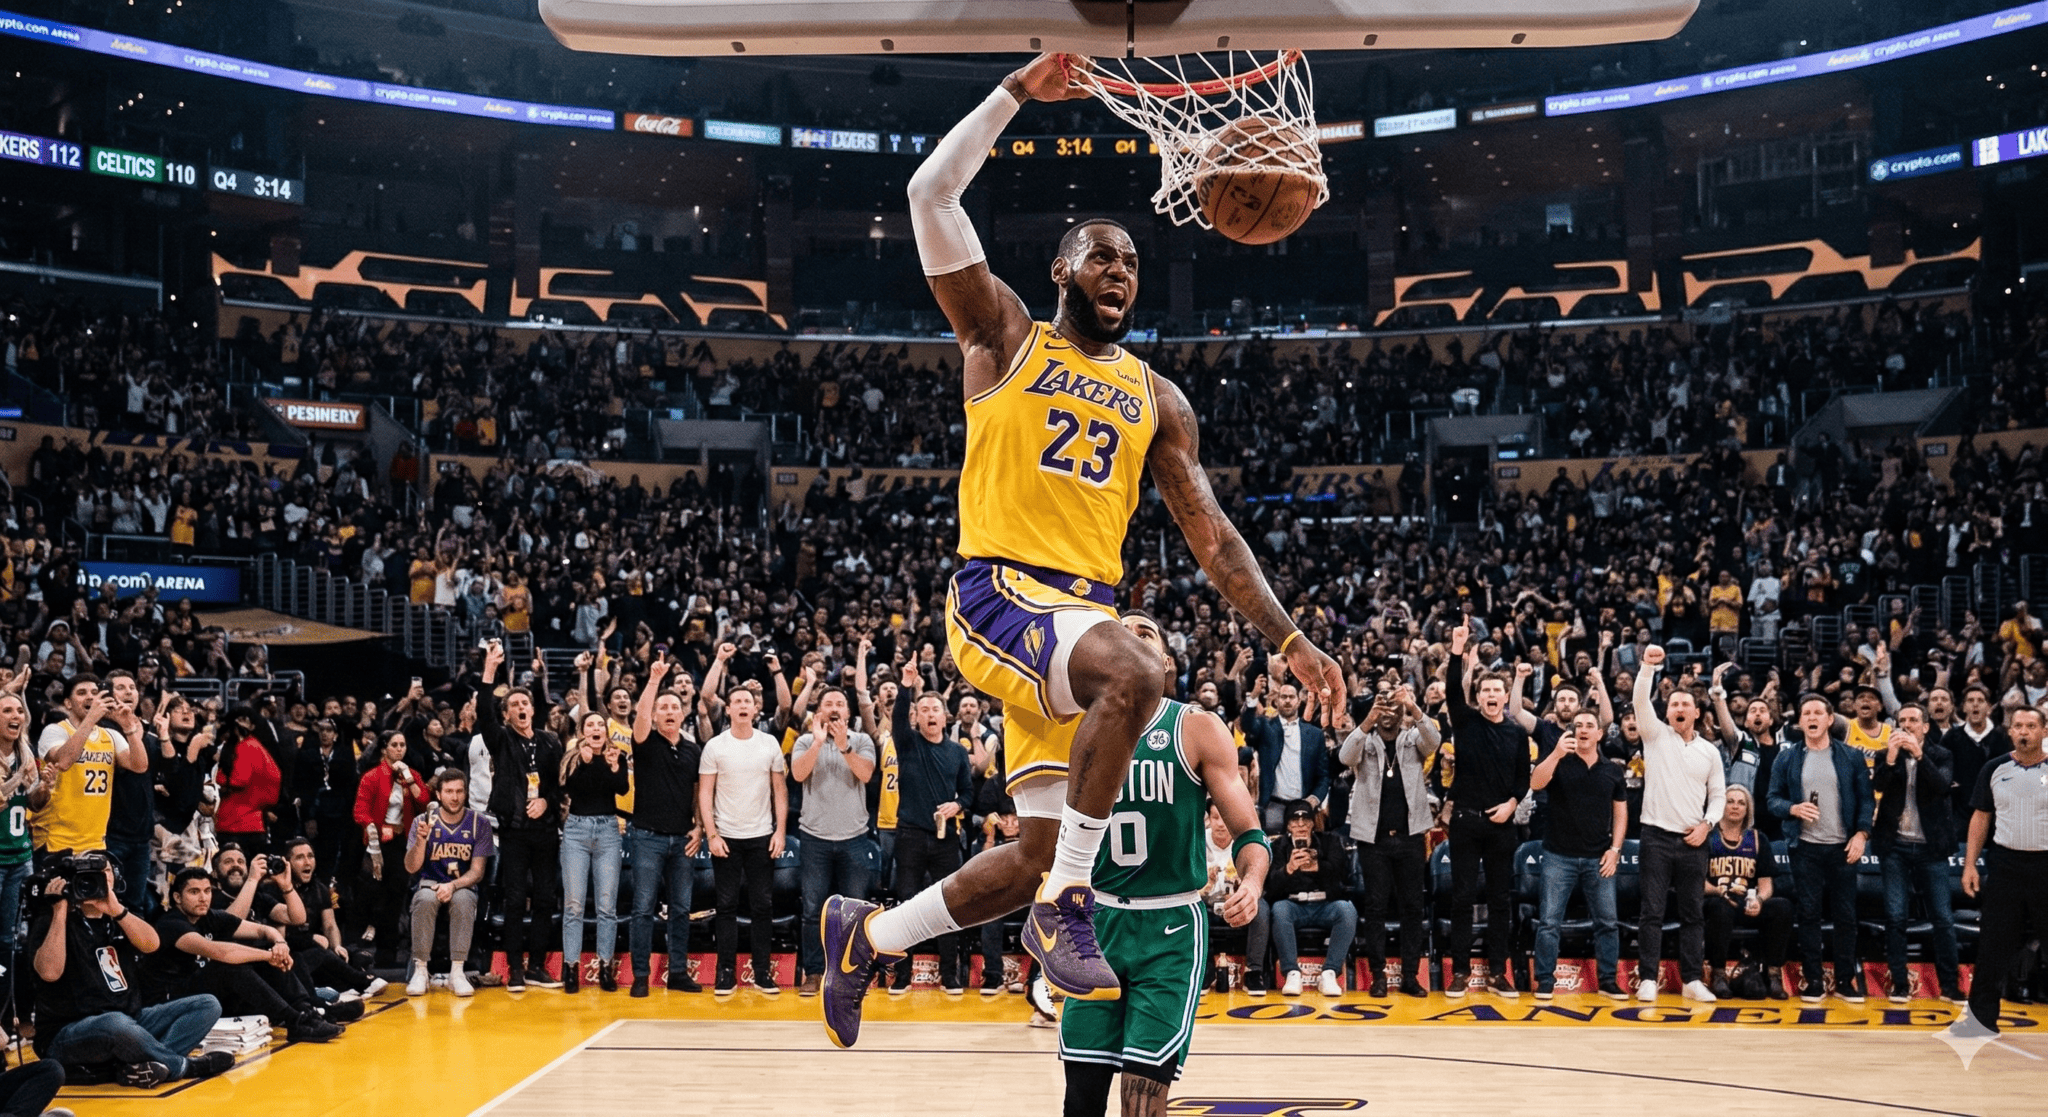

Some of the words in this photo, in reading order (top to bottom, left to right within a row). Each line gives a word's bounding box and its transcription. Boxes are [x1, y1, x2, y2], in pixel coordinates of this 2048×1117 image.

[49, 143, 81, 167] 112
[1012, 140, 1035, 155] Q4
[1056, 137, 1093, 156] 3:14
[97, 150, 156, 178] CELTICS
[166, 162, 195, 185] 110
[1890, 151, 1961, 173] crypto.com
[214, 171, 237, 190] Q4
[254, 175, 292, 199] 3:14
[1023, 358, 1143, 424] LAKERS
[287, 405, 360, 424] PESINERY
[1038, 407, 1121, 489] 23
[155, 576, 205, 590] ARENA
[84, 769, 108, 793] 23
[10, 805, 26, 837] 0
[1109, 811, 1148, 867] 0
[430, 841, 473, 862] LAKERS
[1196, 1003, 1394, 1021] OS
